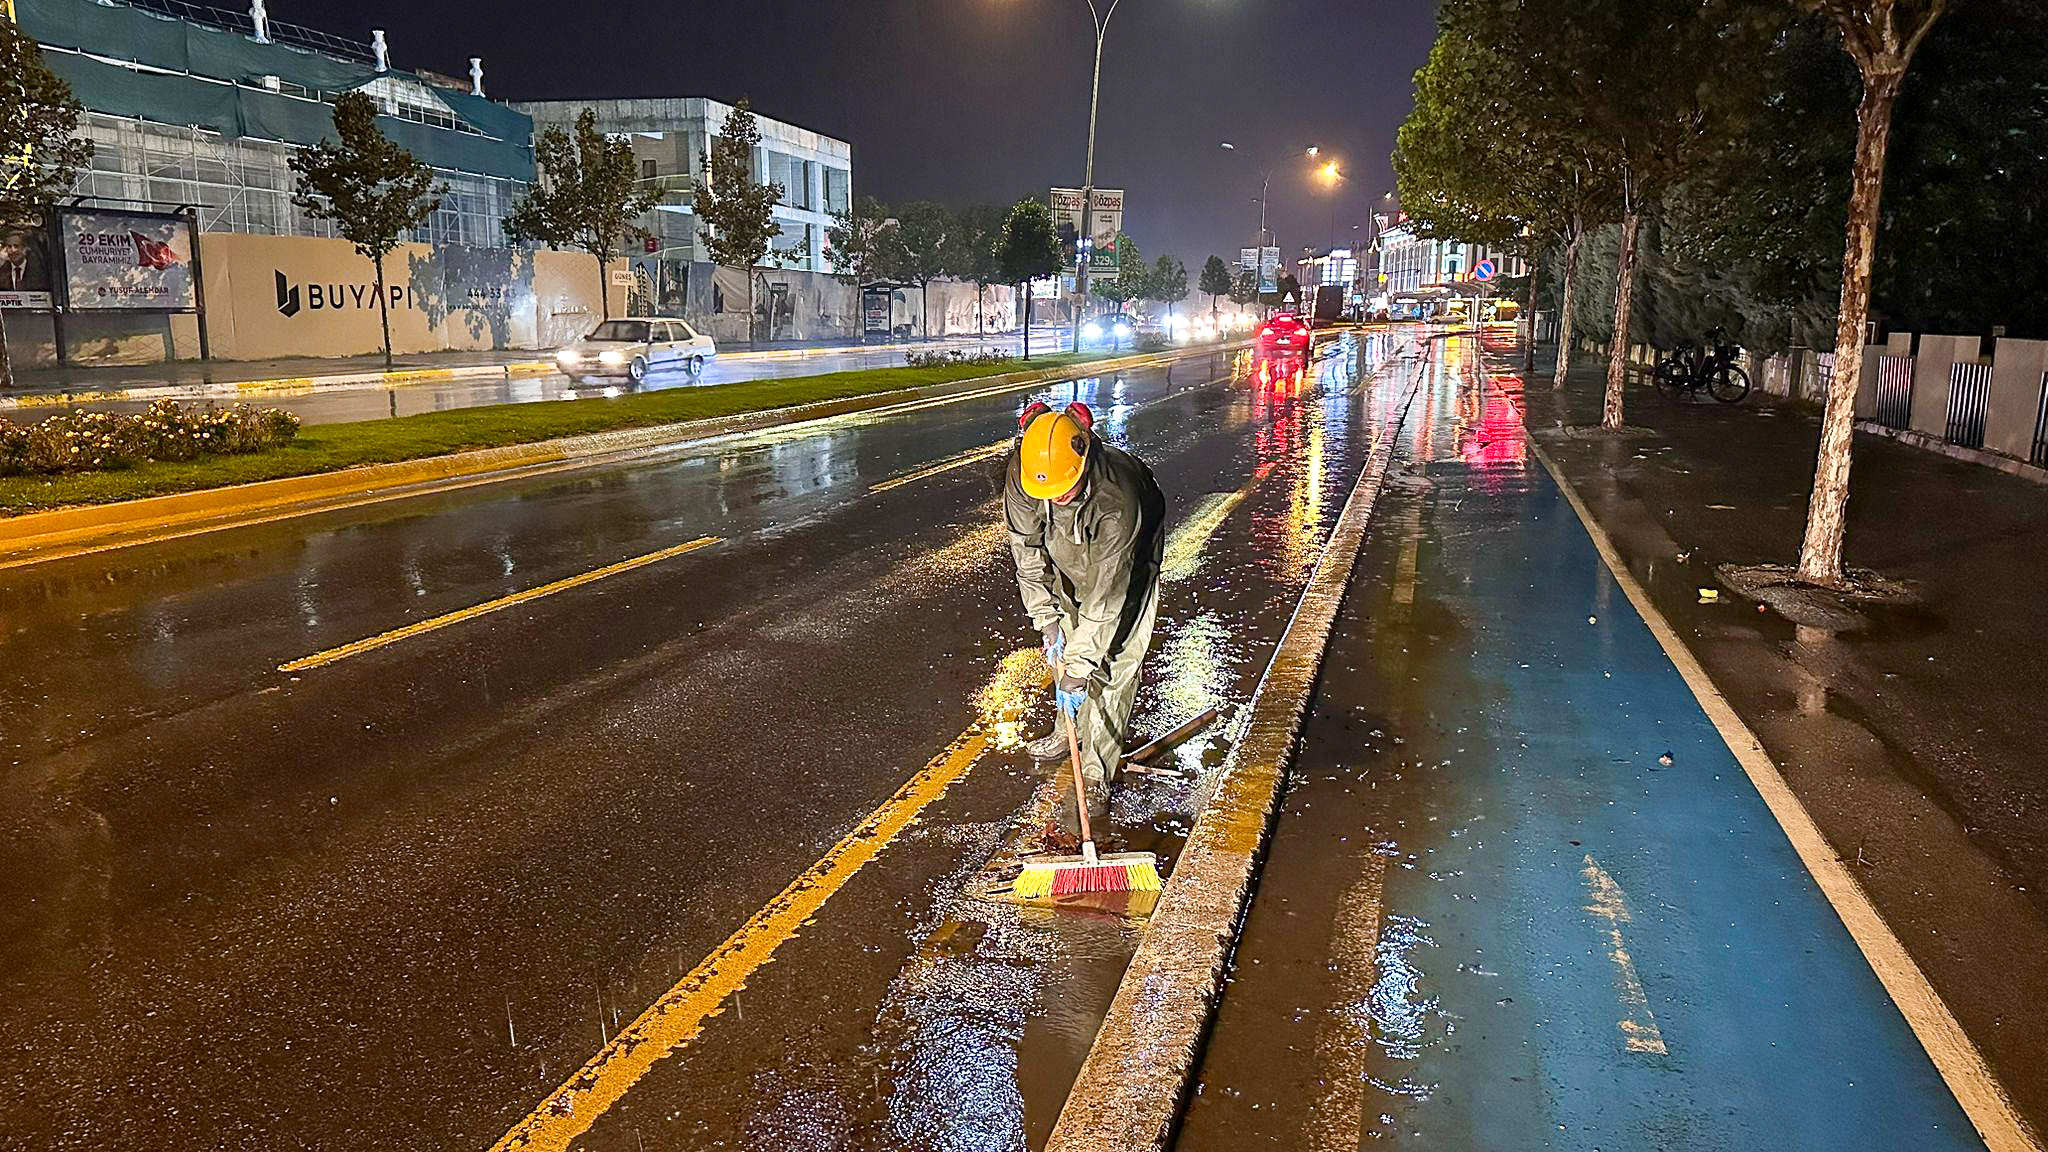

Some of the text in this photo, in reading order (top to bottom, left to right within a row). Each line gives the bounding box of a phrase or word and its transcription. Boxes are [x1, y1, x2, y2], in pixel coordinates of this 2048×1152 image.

[1098, 194, 1121, 209] özpaş
[78, 233, 94, 246] 29
[467, 287, 486, 299] 444
